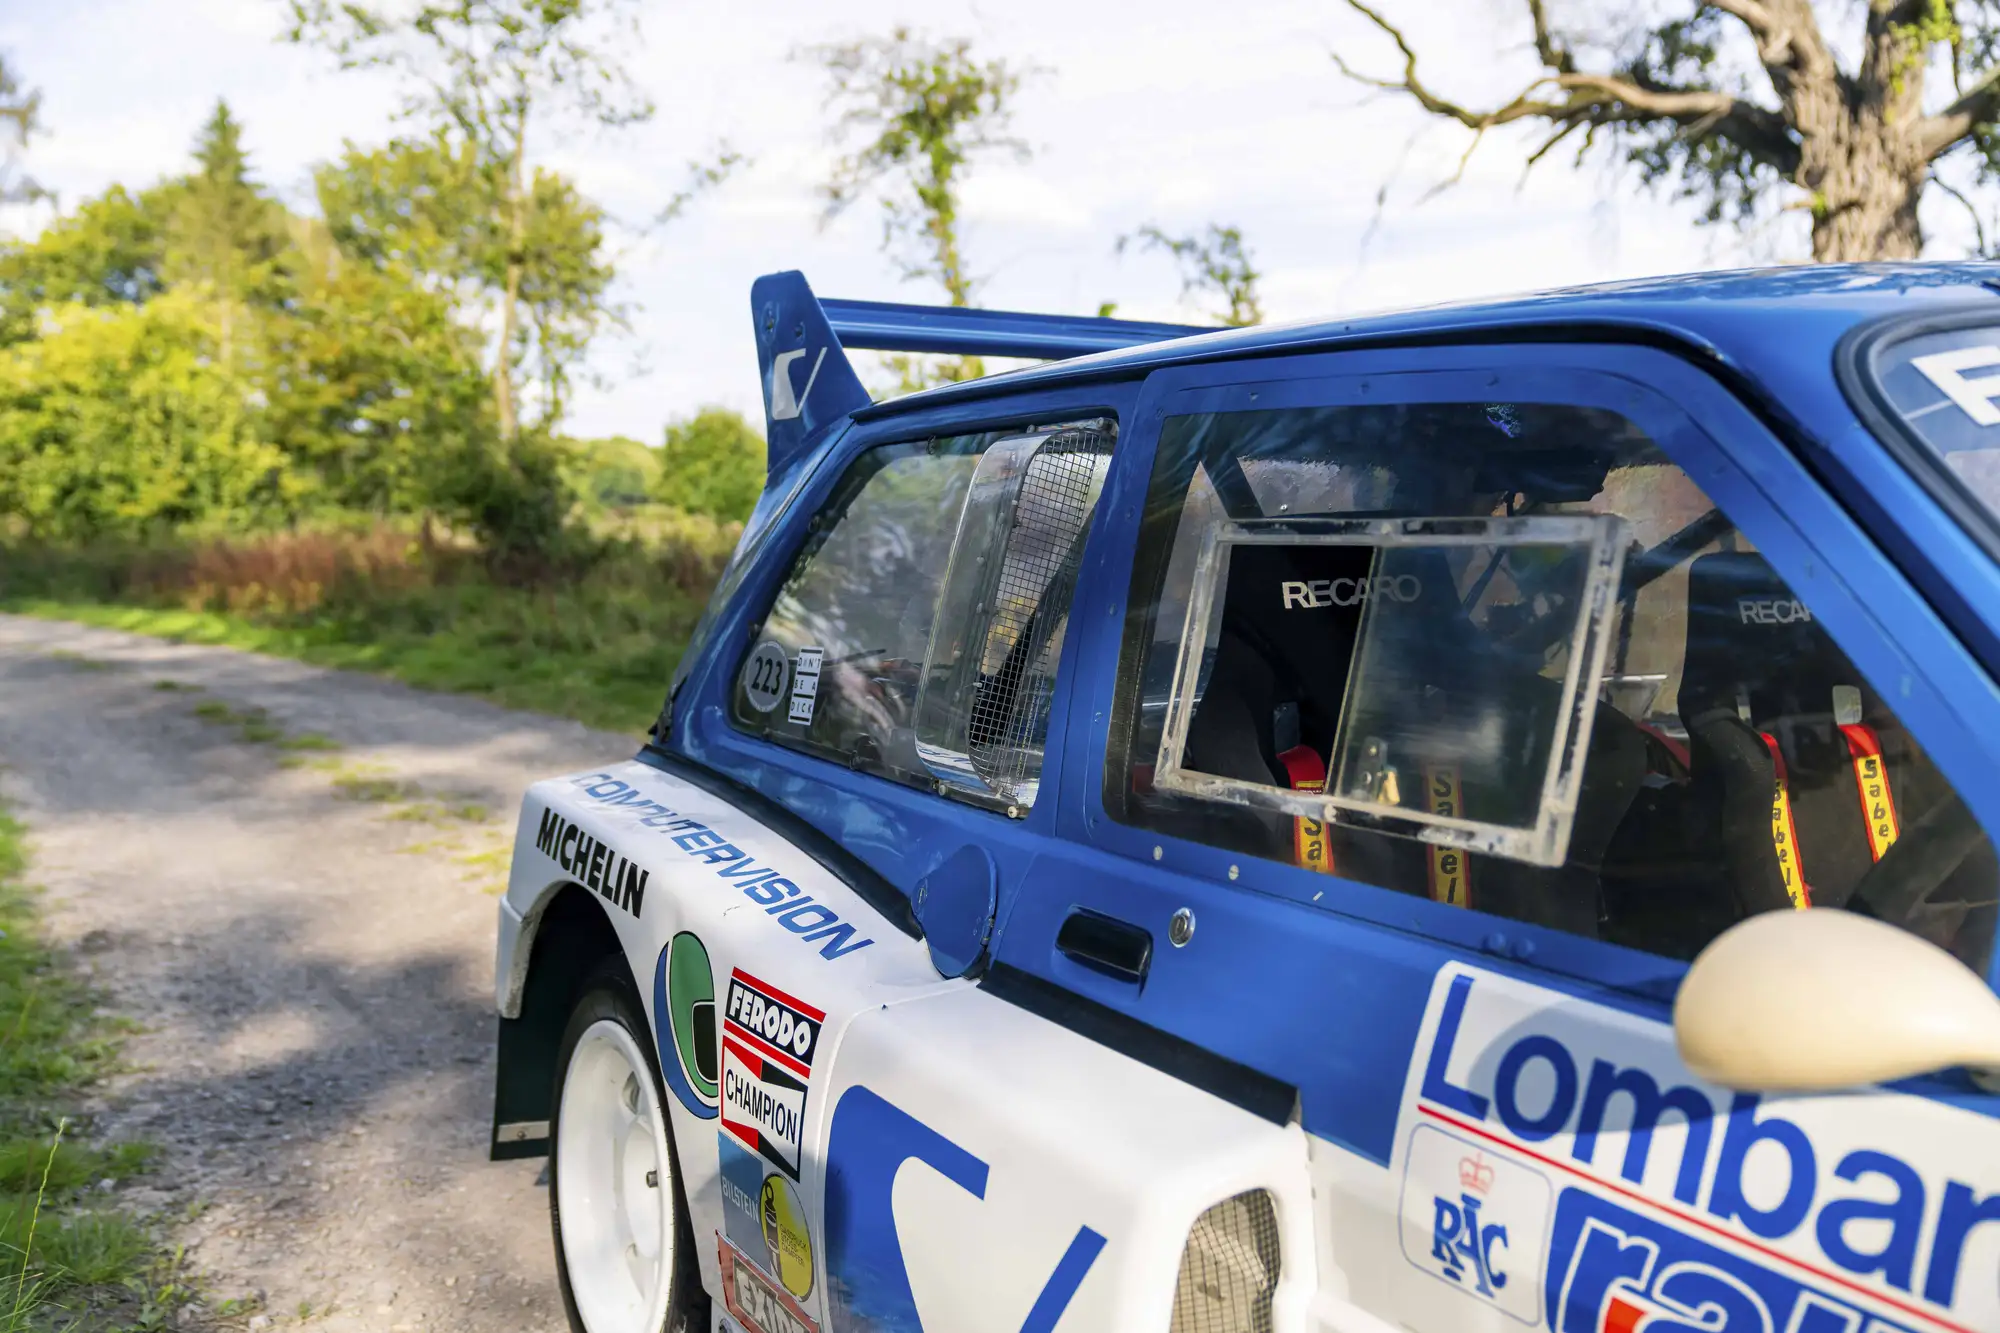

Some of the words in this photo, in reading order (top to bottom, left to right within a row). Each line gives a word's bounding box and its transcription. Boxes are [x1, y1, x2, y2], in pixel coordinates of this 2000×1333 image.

[1281, 574, 1422, 609] RECARO
[750, 656, 782, 695] 223
[790, 702, 813, 714] DICK
[794, 680, 804, 690] BE
[811, 681, 816, 691] A
[1863, 759, 1892, 849] Sabe
[536, 807, 649, 919] MICHELIN
[571, 773, 875, 961] COMPUTERVISION
[728, 984, 812, 1056] FERODO
[725, 1068, 798, 1145] CHAMPION
[721, 1175, 760, 1224] BILSTEIN
[1431, 1192, 1509, 1299] RAC
[736, 1268, 806, 1333] EXID
